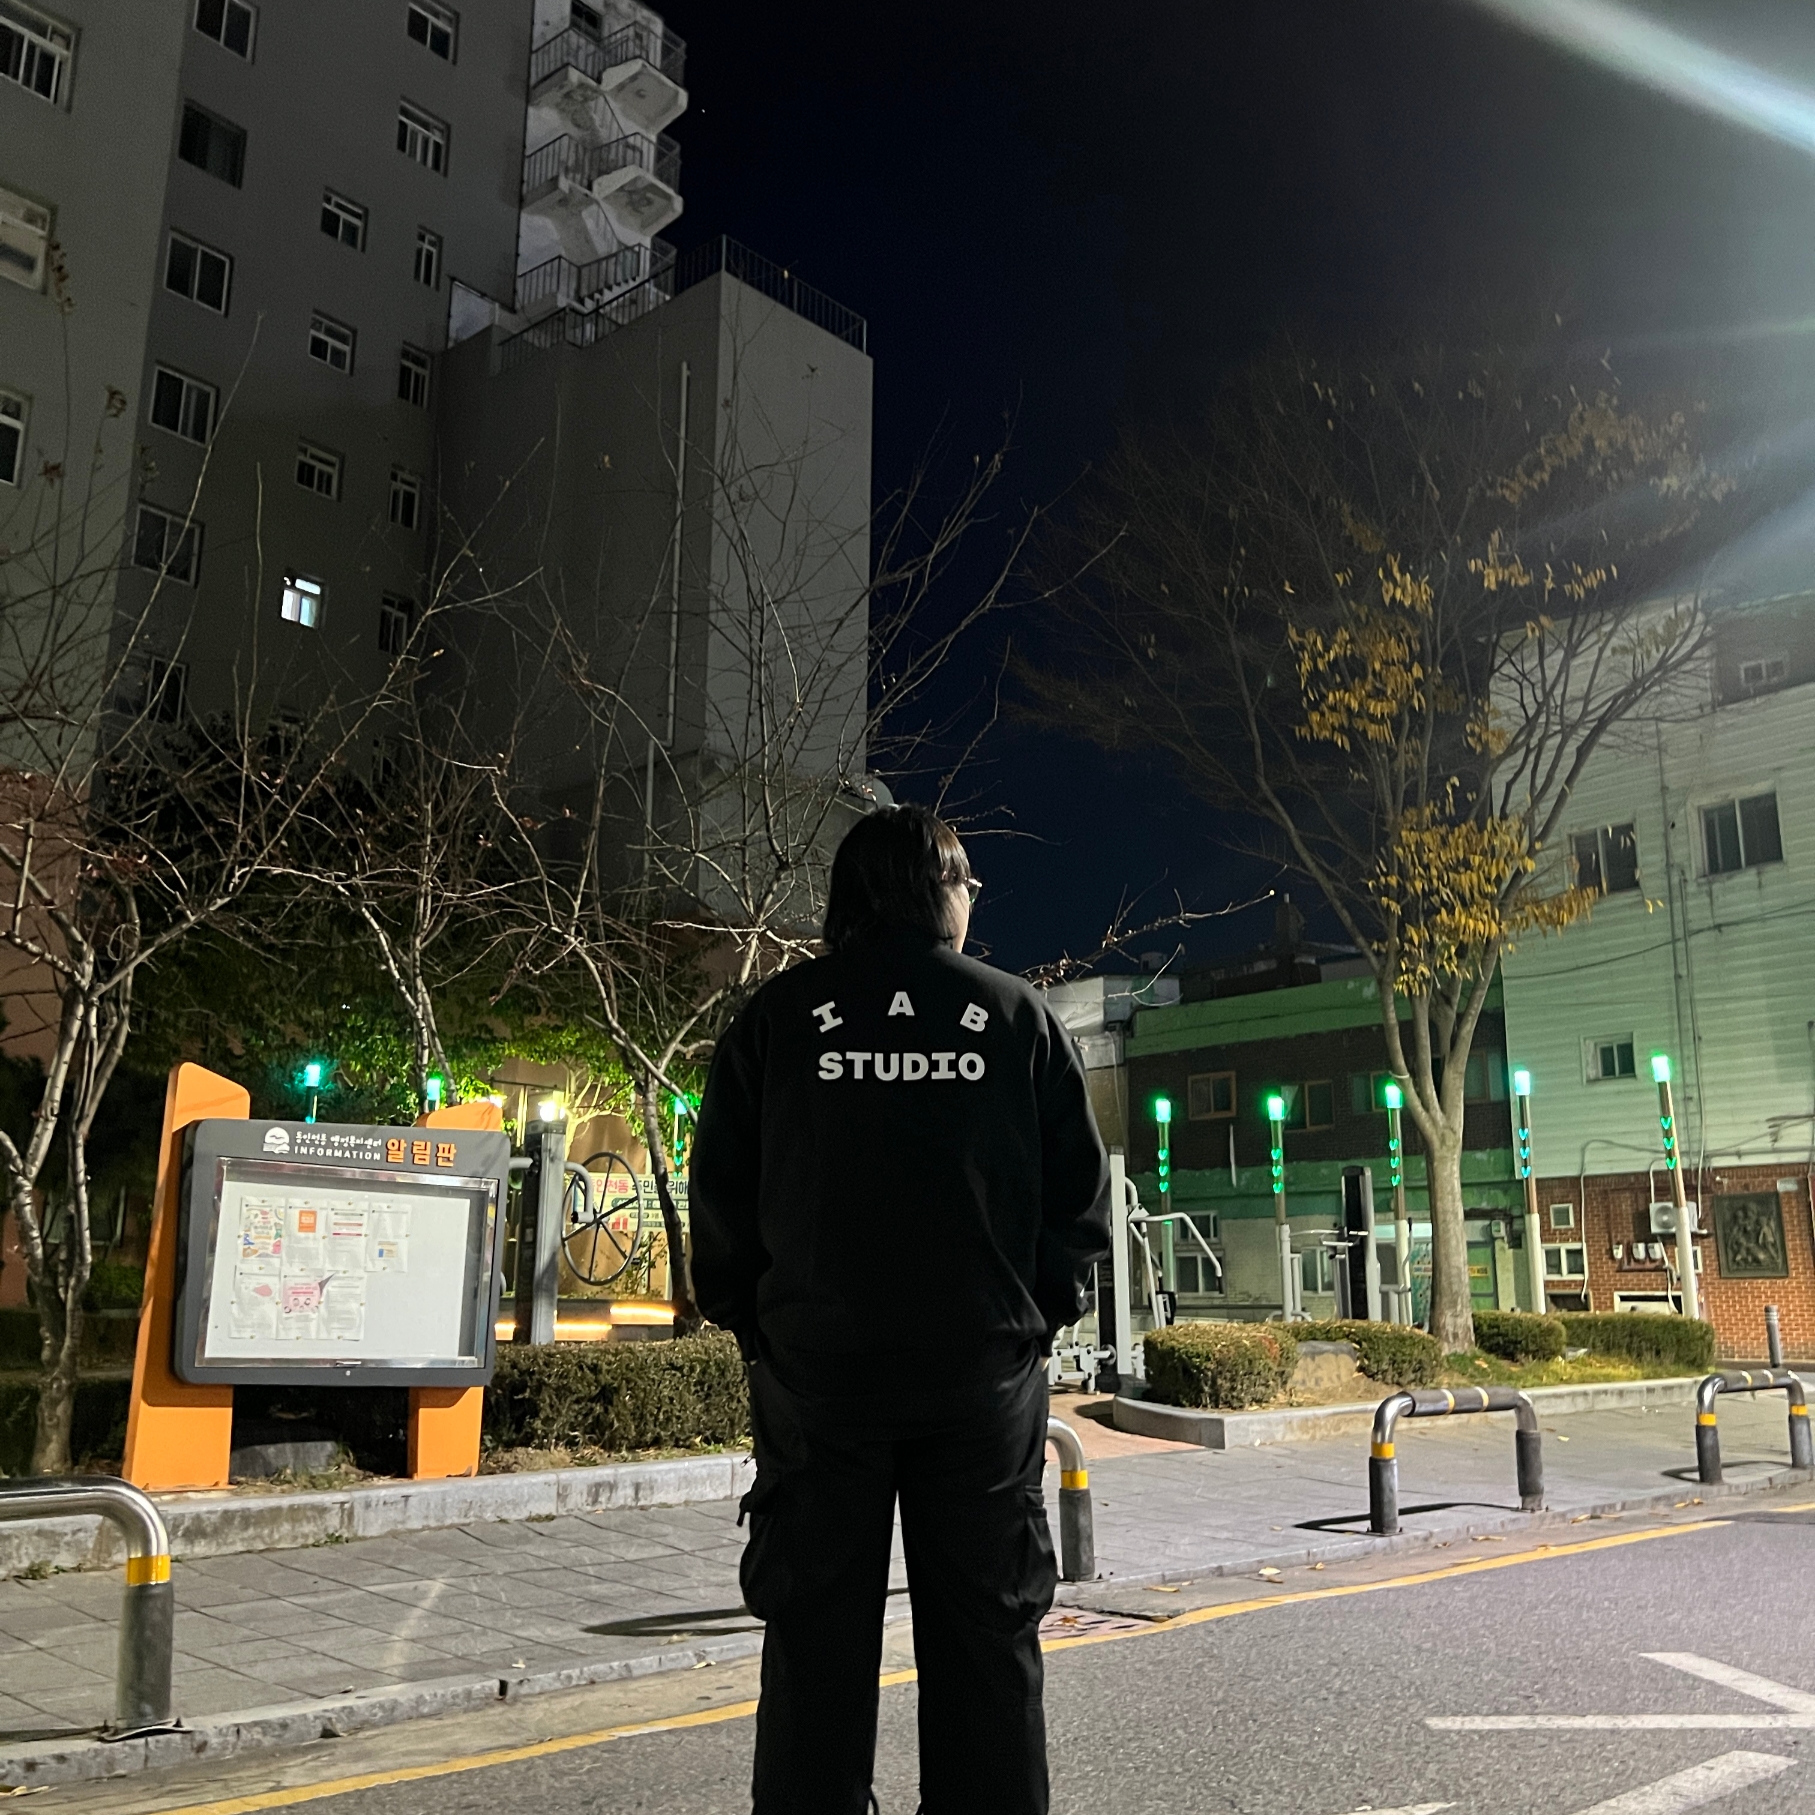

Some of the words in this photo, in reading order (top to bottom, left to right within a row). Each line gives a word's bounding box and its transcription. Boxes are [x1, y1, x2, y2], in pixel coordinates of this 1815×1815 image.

[818, 1051, 985, 1082] STUDIO
[294, 1145, 381, 1161] INFORMATION
[386, 1138, 457, 1167] 알림판
